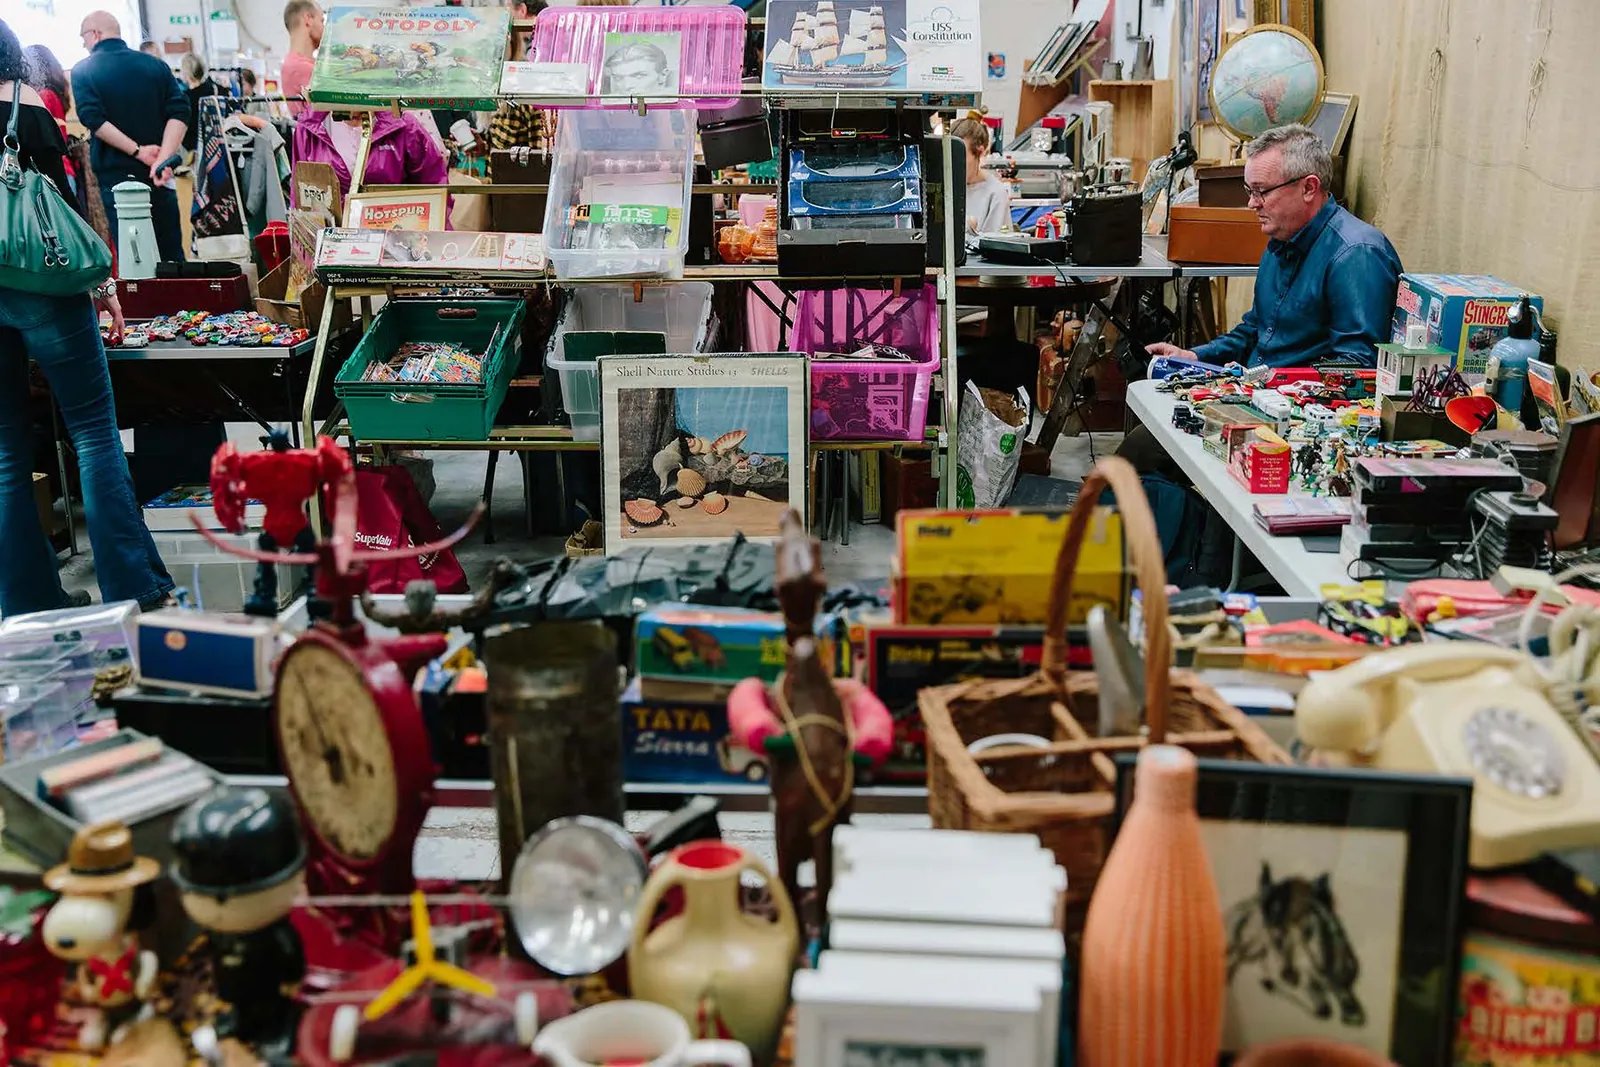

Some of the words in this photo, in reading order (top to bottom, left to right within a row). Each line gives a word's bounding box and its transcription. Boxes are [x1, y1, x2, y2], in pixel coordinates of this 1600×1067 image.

[353, 17, 477, 31] TOTOPOLY
[932, 22, 952, 31] USS
[912, 31, 972, 41] Constitution
[364, 205, 425, 220] HOTSPUR
[603, 203, 653, 218] films
[1463, 301, 1510, 325] STINGR
[616, 366, 642, 377] Shell
[647, 366, 684, 377] Nature
[687, 365, 725, 376] Studies
[751, 367, 789, 376] SHELLS
[354, 531, 393, 547] SuperValu
[632, 707, 711, 731] TATA
[1471, 1004, 1565, 1046] BIRCH
[1576, 1011, 1600, 1044] B
